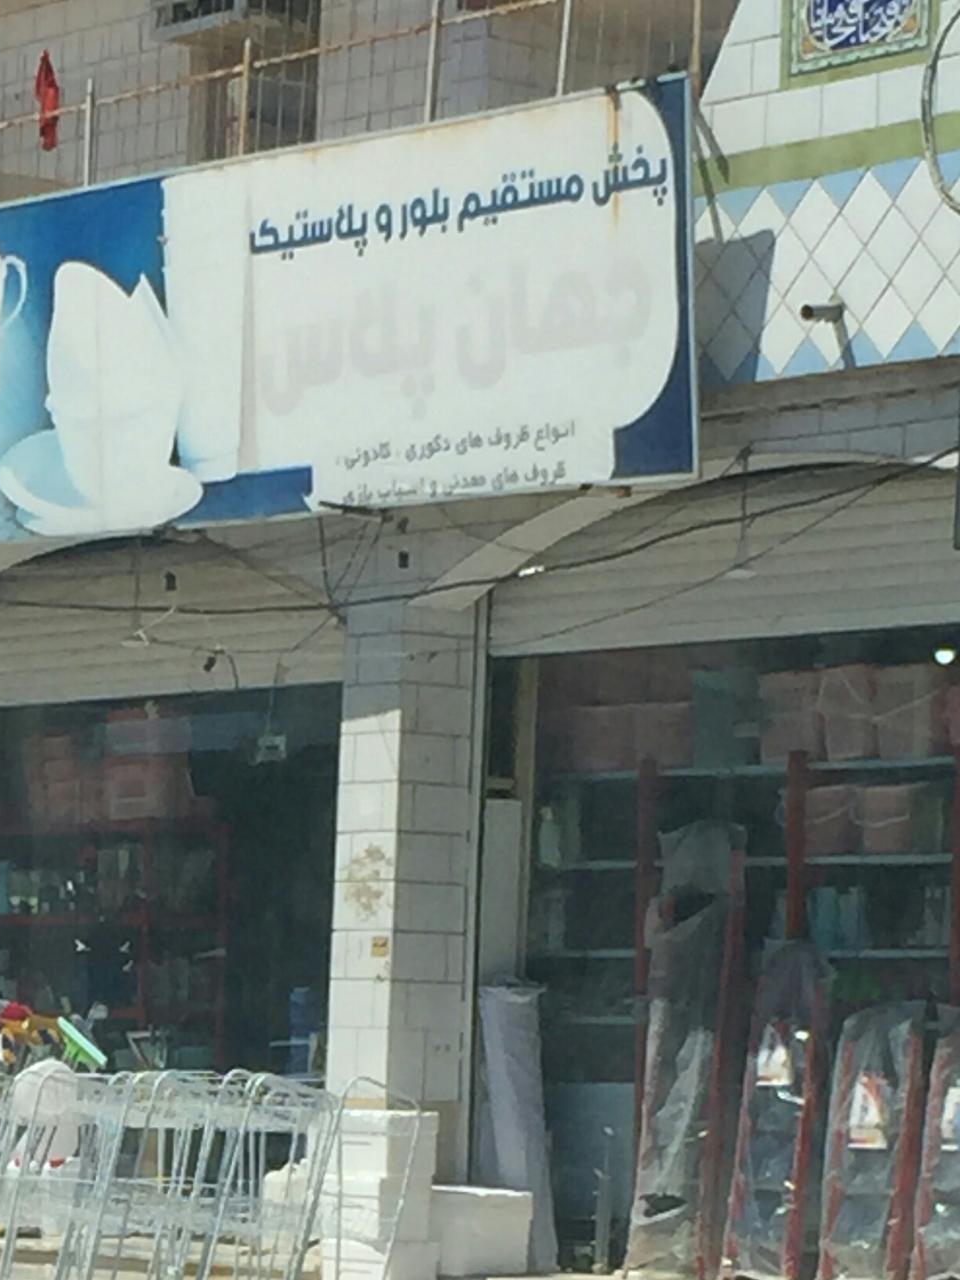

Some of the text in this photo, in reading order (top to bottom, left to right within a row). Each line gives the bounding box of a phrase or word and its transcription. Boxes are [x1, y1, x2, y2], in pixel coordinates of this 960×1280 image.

[248, 142, 668, 261] پخش مستقیم بلور و پلاستیک
[259, 256, 653, 421] جهان پلاس
[454, 431, 484, 456] های
[487, 424, 531, 451] ظروف
[533, 420, 576, 452] انواع
[490, 467, 520, 492] های
[524, 460, 567, 488] ظروف
